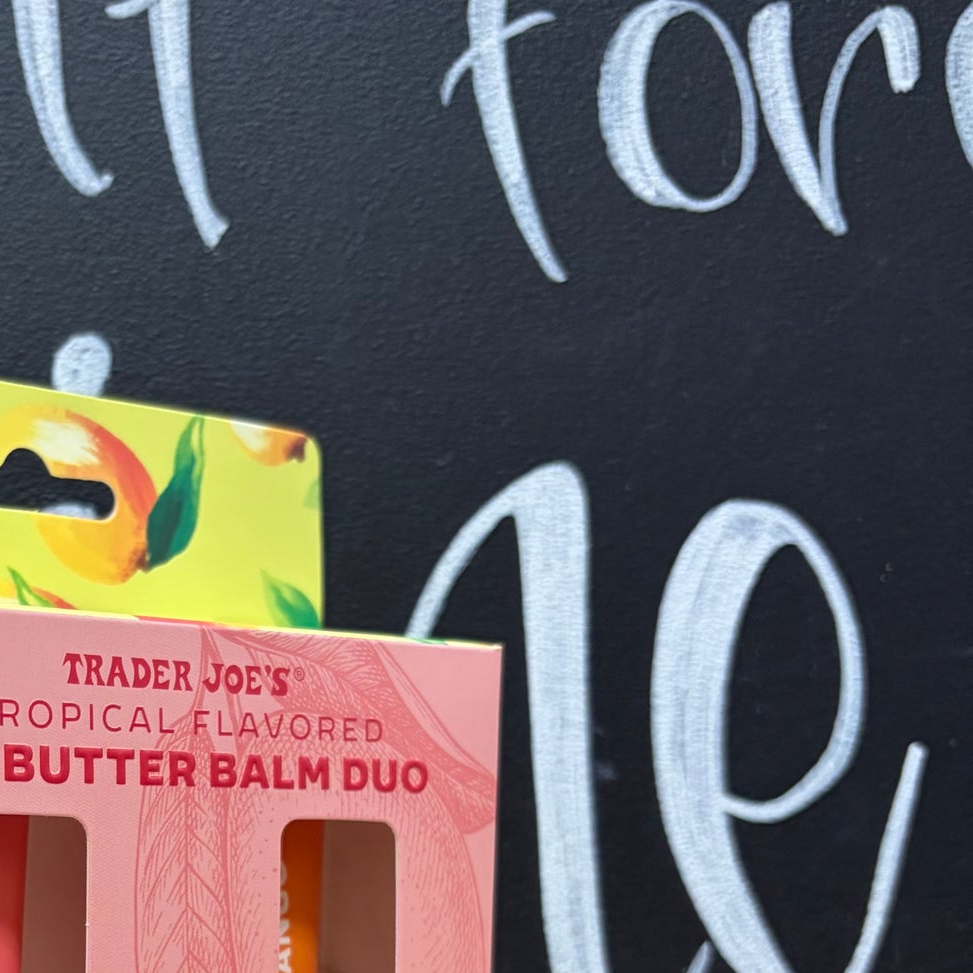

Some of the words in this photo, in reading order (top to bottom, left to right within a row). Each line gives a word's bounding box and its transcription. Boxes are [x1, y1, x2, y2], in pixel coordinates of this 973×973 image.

[62, 652, 193, 691] TRADER
[193, 710, 385, 743] FLAVORED
[3, 743, 198, 788] BUTTER
[209, 750, 330, 791] BALM
[342, 758, 429, 795] DUO
